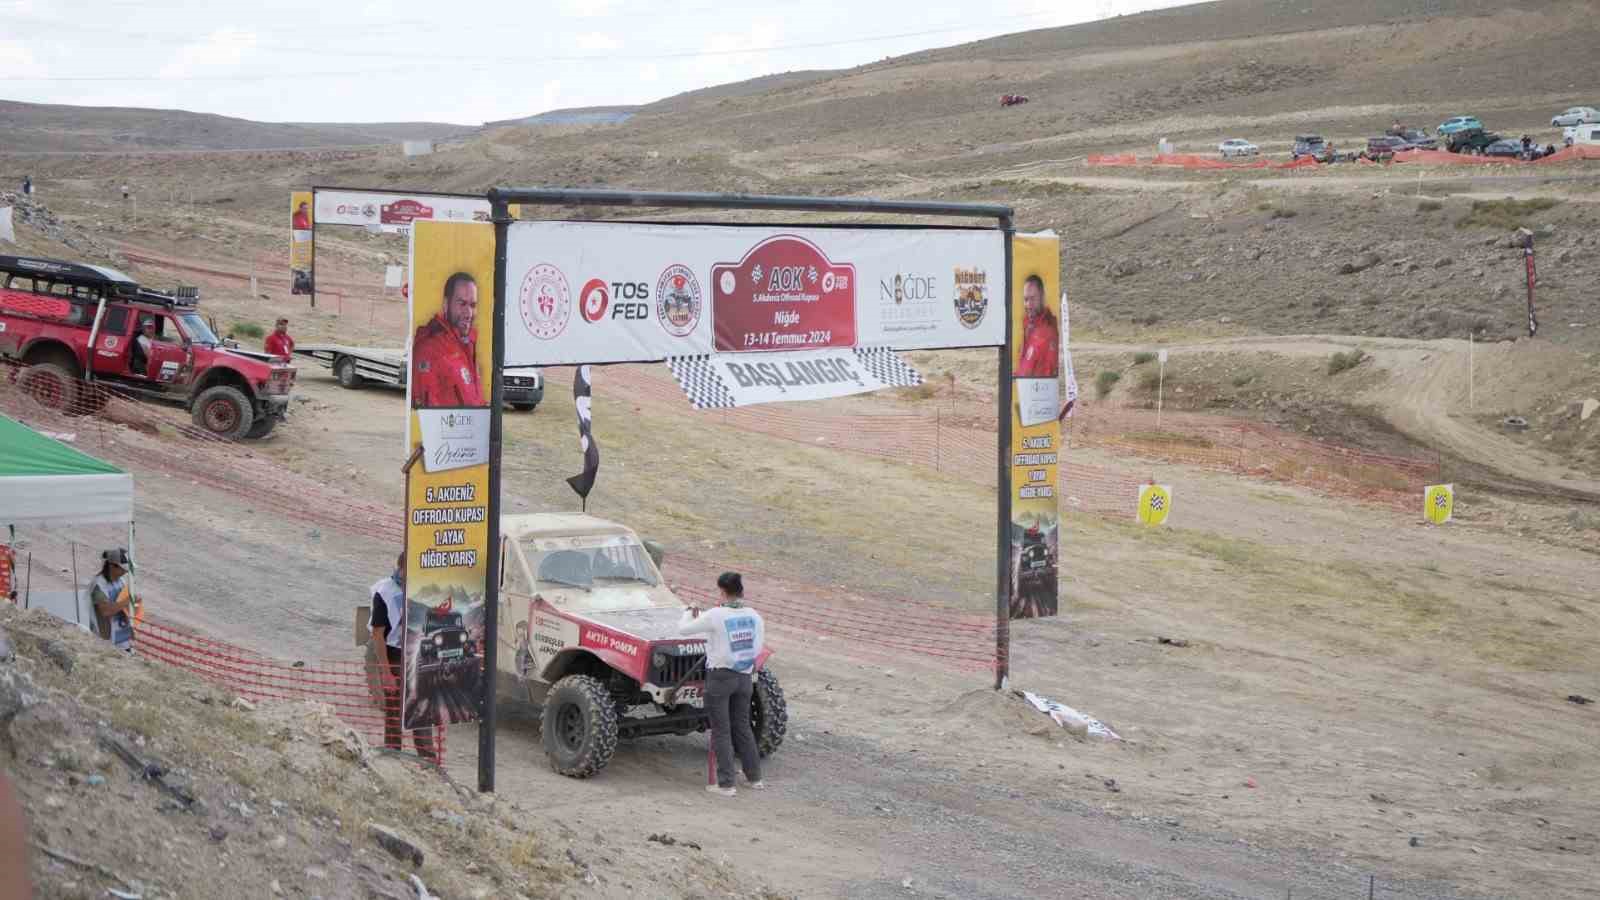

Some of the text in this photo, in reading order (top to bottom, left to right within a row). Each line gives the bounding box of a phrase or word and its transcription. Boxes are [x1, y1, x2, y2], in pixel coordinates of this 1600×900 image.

[767, 266, 804, 291] AOK
[611, 282, 649, 299] TOS
[611, 303, 649, 320] FED
[774, 310, 800, 327] Niğde
[744, 330, 831, 345] 13-14 Temmuz 2024
[725, 357, 864, 393] BAŞLANGIÇ
[413, 507, 485, 525] OFFROAD KUPASI
[678, 643, 705, 656] POM
